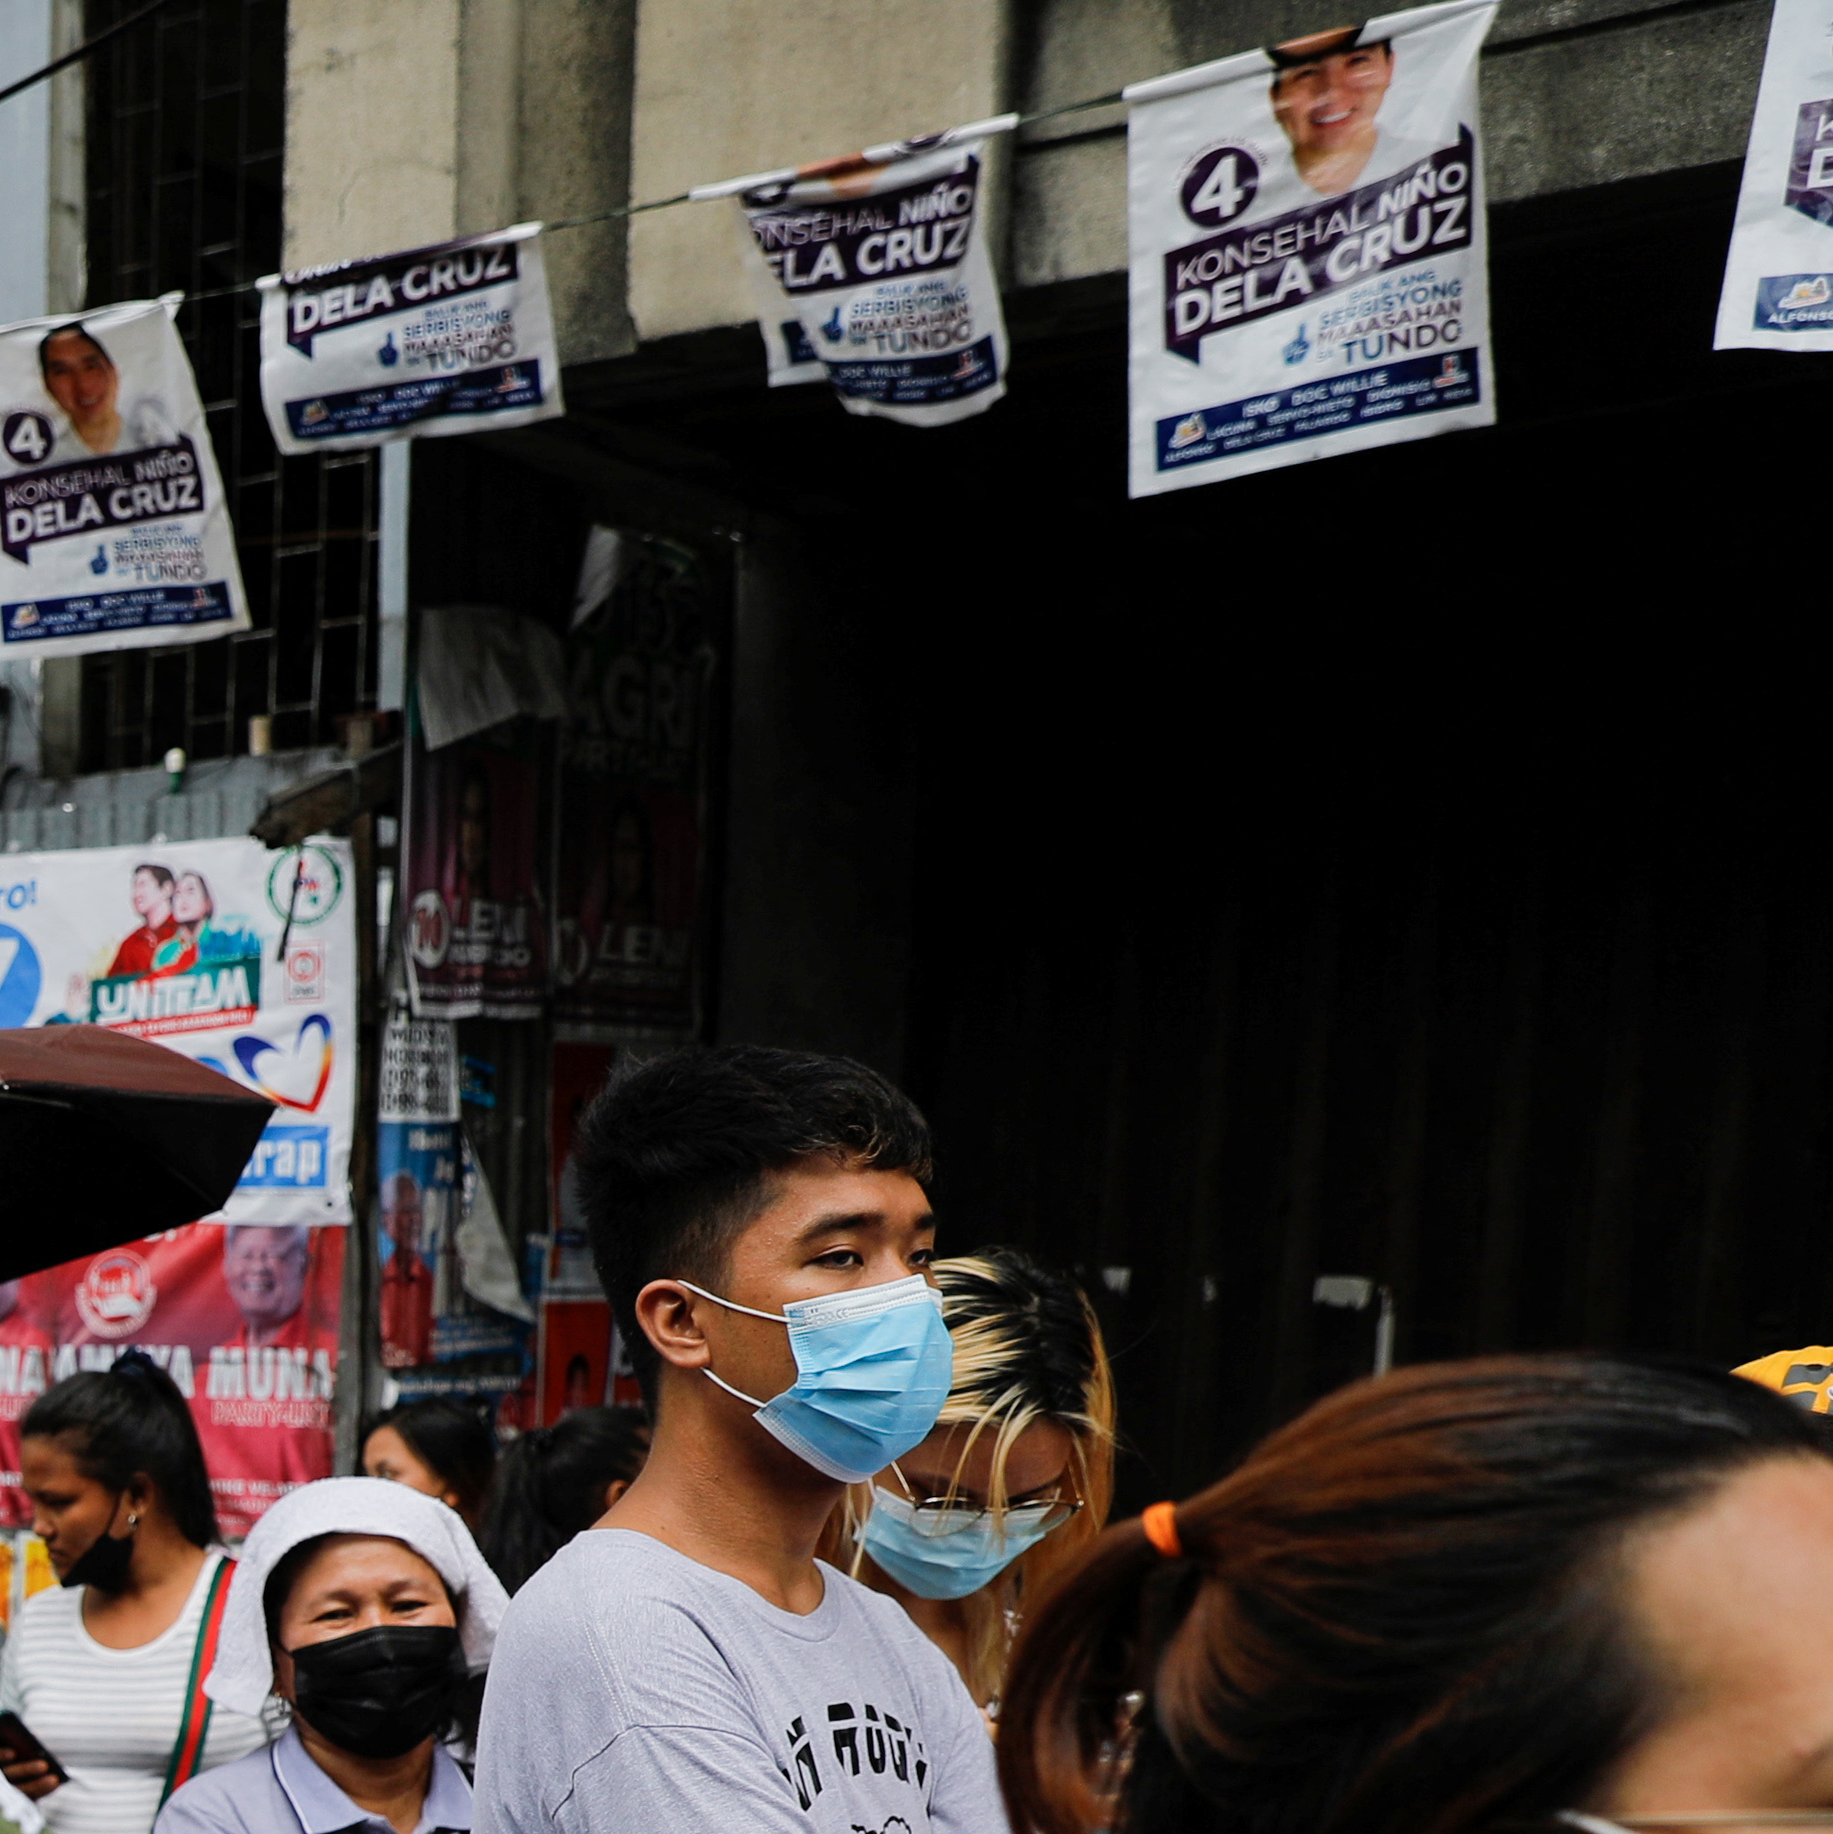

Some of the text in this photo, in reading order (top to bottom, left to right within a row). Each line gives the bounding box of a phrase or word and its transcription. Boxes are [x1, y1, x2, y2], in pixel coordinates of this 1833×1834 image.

[898, 182, 974, 226] NIÑO
[1190, 154, 1244, 218] 4
[854, 217, 972, 276] CRUZ
[1176, 160, 1469, 289] KONSEHAL NIÑO
[292, 247, 513, 335] DELA CRUZ
[1174, 194, 1469, 338] DELA CRUZ
[873, 321, 974, 354] TUNDO
[1341, 318, 1463, 364] TUNDO
[8, 415, 47, 460] 4
[5, 464, 133, 510] KONSEHAL
[6, 473, 202, 544] DELA CRUZ
[241, 1139, 323, 1185] rap
[206, 1346, 335, 1400] MUNA
